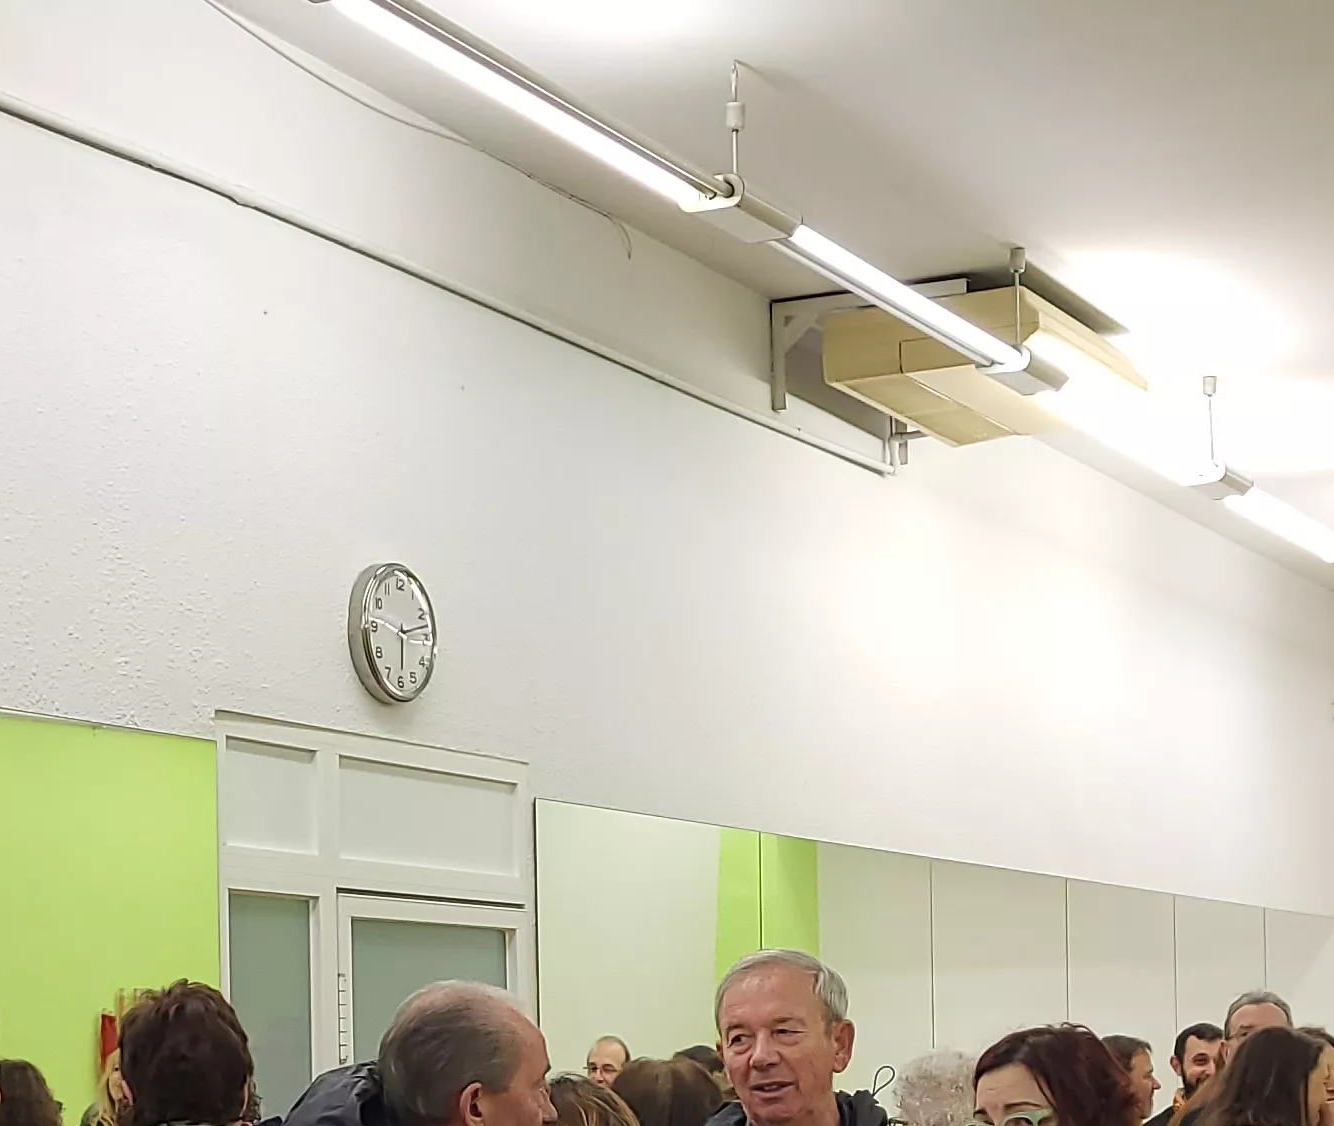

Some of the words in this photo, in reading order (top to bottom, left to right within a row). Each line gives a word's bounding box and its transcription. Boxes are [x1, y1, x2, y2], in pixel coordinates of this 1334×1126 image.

[396, 578, 405, 591] 12
[375, 597, 383, 610] 10
[418, 607, 425, 620] 2
[371, 620, 378, 633] 9
[375, 646, 383, 659] 8
[418, 656, 426, 668] 4
[384, 666, 391, 679] 7
[409, 671, 417, 684] 5
[397, 676, 405, 689] 6
